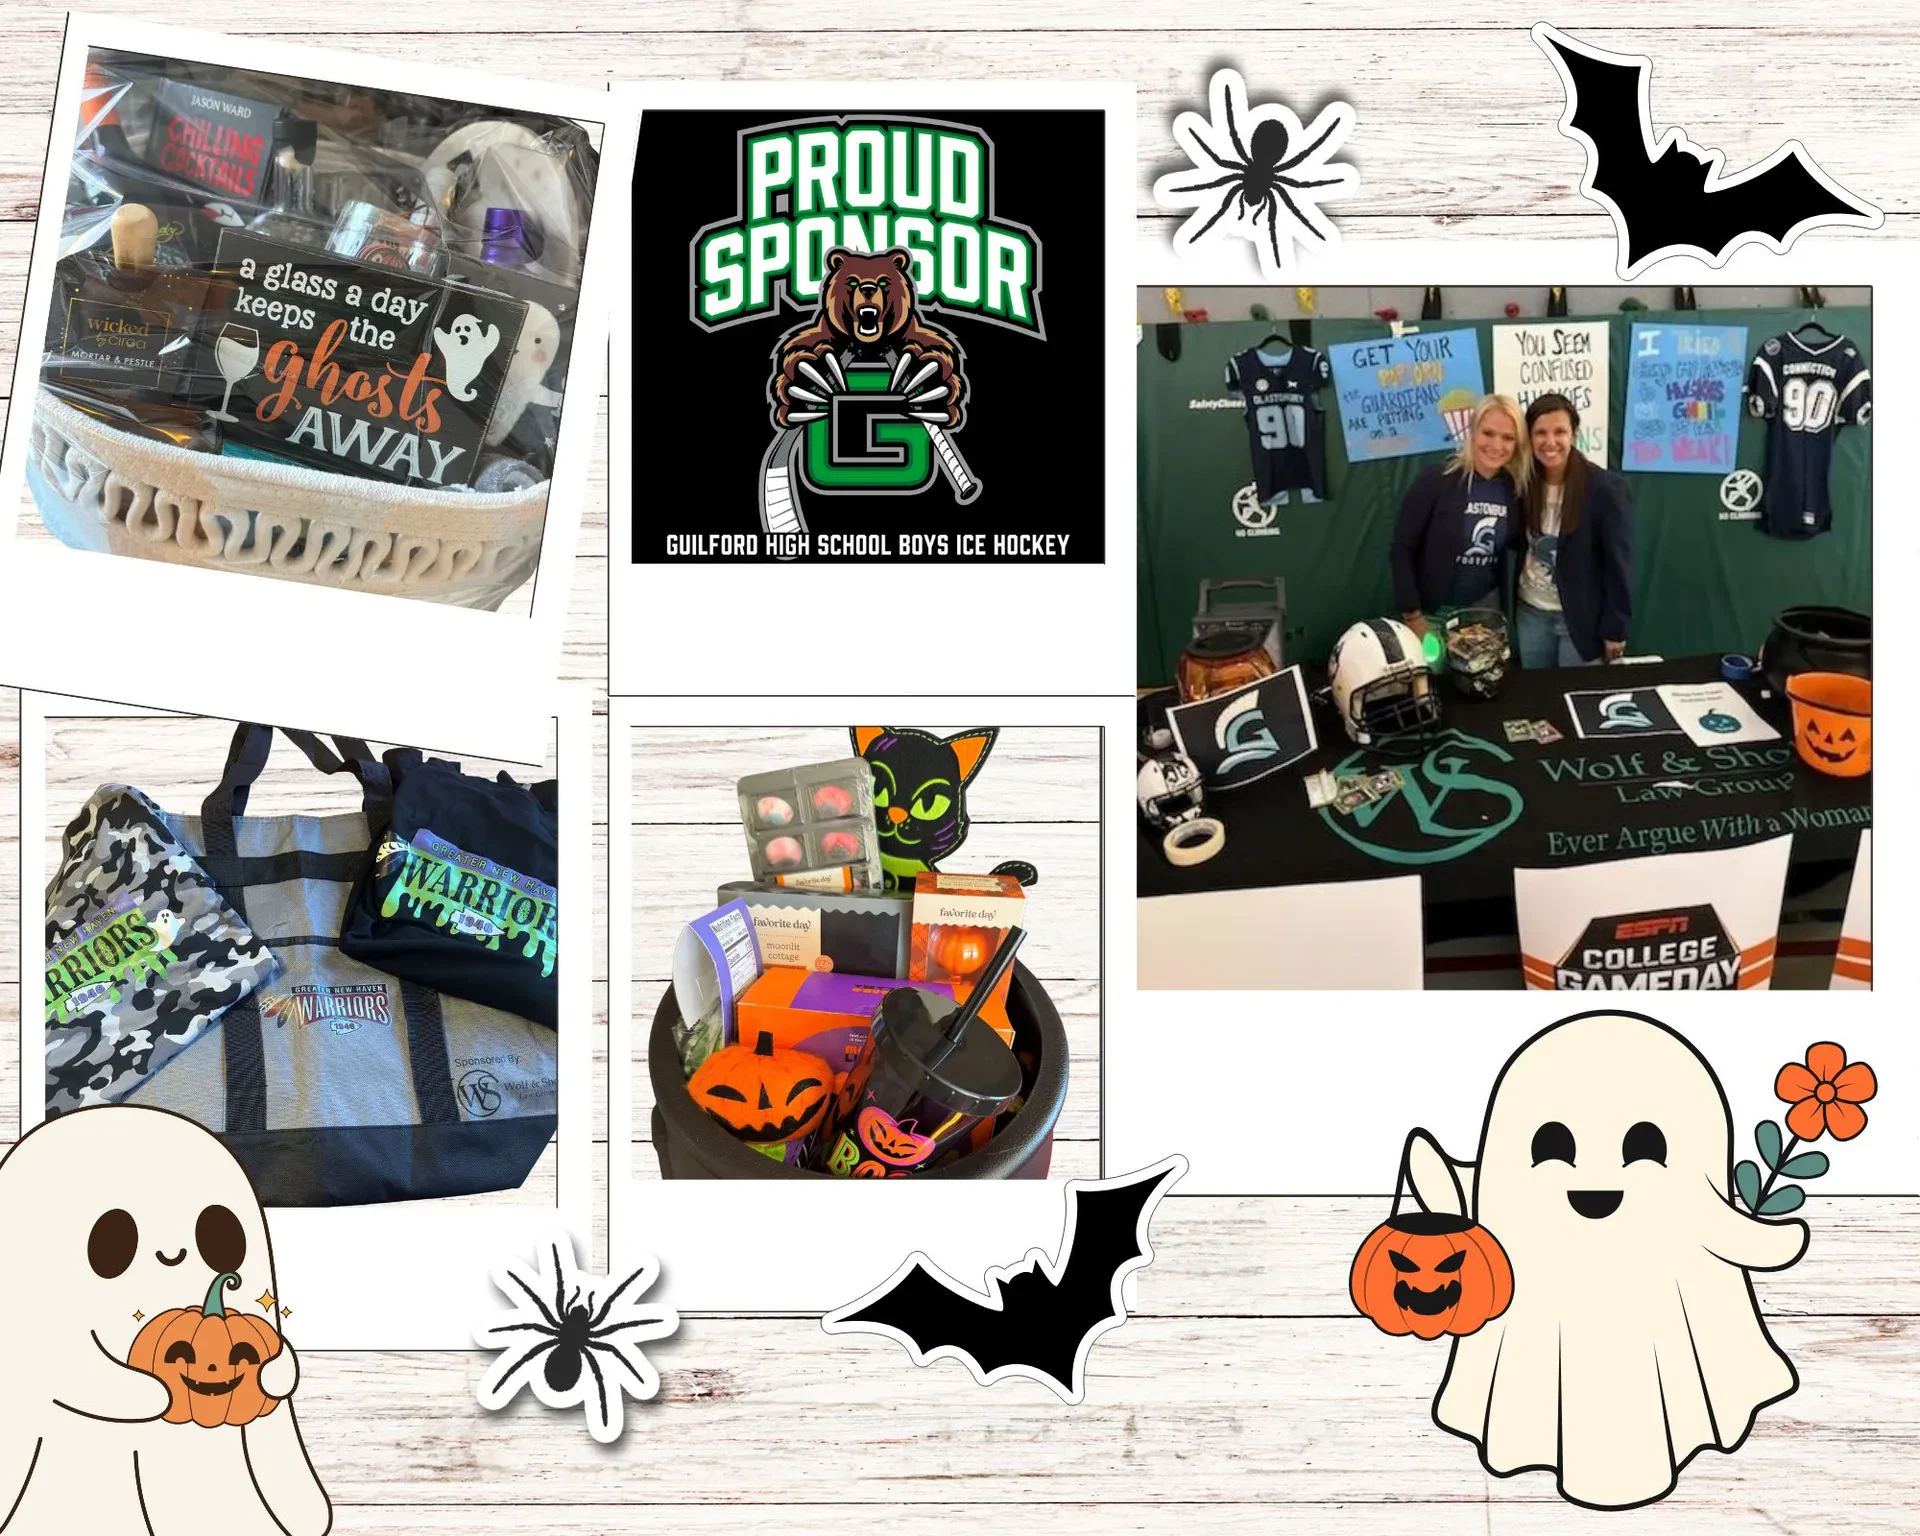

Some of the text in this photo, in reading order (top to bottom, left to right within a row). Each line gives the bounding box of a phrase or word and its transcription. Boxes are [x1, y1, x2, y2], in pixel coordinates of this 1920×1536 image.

[190, 94, 252, 119] JASON WARD
[168, 113, 264, 167] CHILLING
[161, 142, 257, 197] COCKTAILS
[748, 124, 985, 222] PROUD
[239, 257, 429, 326] a glass a day
[88, 317, 150, 336] wicked
[234, 287, 396, 350] keeps the
[1352, 336, 1453, 368] GET YOUR
[1515, 329, 1591, 356] YOU SEEM
[71, 350, 111, 361] MORTAR
[114, 356, 120, 364] &
[124, 357, 155, 368] PESTLE
[1520, 358, 1593, 384] CONFUSED
[255, 318, 447, 434] ghosts
[1783, 378, 1838, 433] 90
[1256, 405, 1305, 450] 90
[285, 406, 467, 485] AWAY
[666, 534, 1070, 556] GUILFORD HIGH SCHOOL BOYS ICE HOCKEY
[1538, 752, 1647, 783] Wolf
[1662, 750, 1702, 774] &
[1694, 771, 1795, 797] Group
[1546, 831, 1609, 856] Ever
[1616, 826, 1697, 854] Argue
[1701, 814, 1761, 842] With
[1767, 818, 1781, 833] a
[432, 842, 487, 869] GREATER
[492, 866, 520, 883] NEW
[753, 916, 811, 932] favorite day
[939, 908, 996, 920] favorite day
[55, 907, 116, 954] NEW HAVEN
[766, 942, 800, 950] moonlit
[768, 953, 799, 962] cottage
[1582, 935, 1718, 971] COLLEGE
[356, 984, 383, 993] HAVEN
[1556, 954, 1742, 991] GAMEDAY
[296, 995, 388, 1026] WARRIORS
[454, 1056, 506, 1068] Sponsored
[504, 1081, 528, 1091] Wolf
